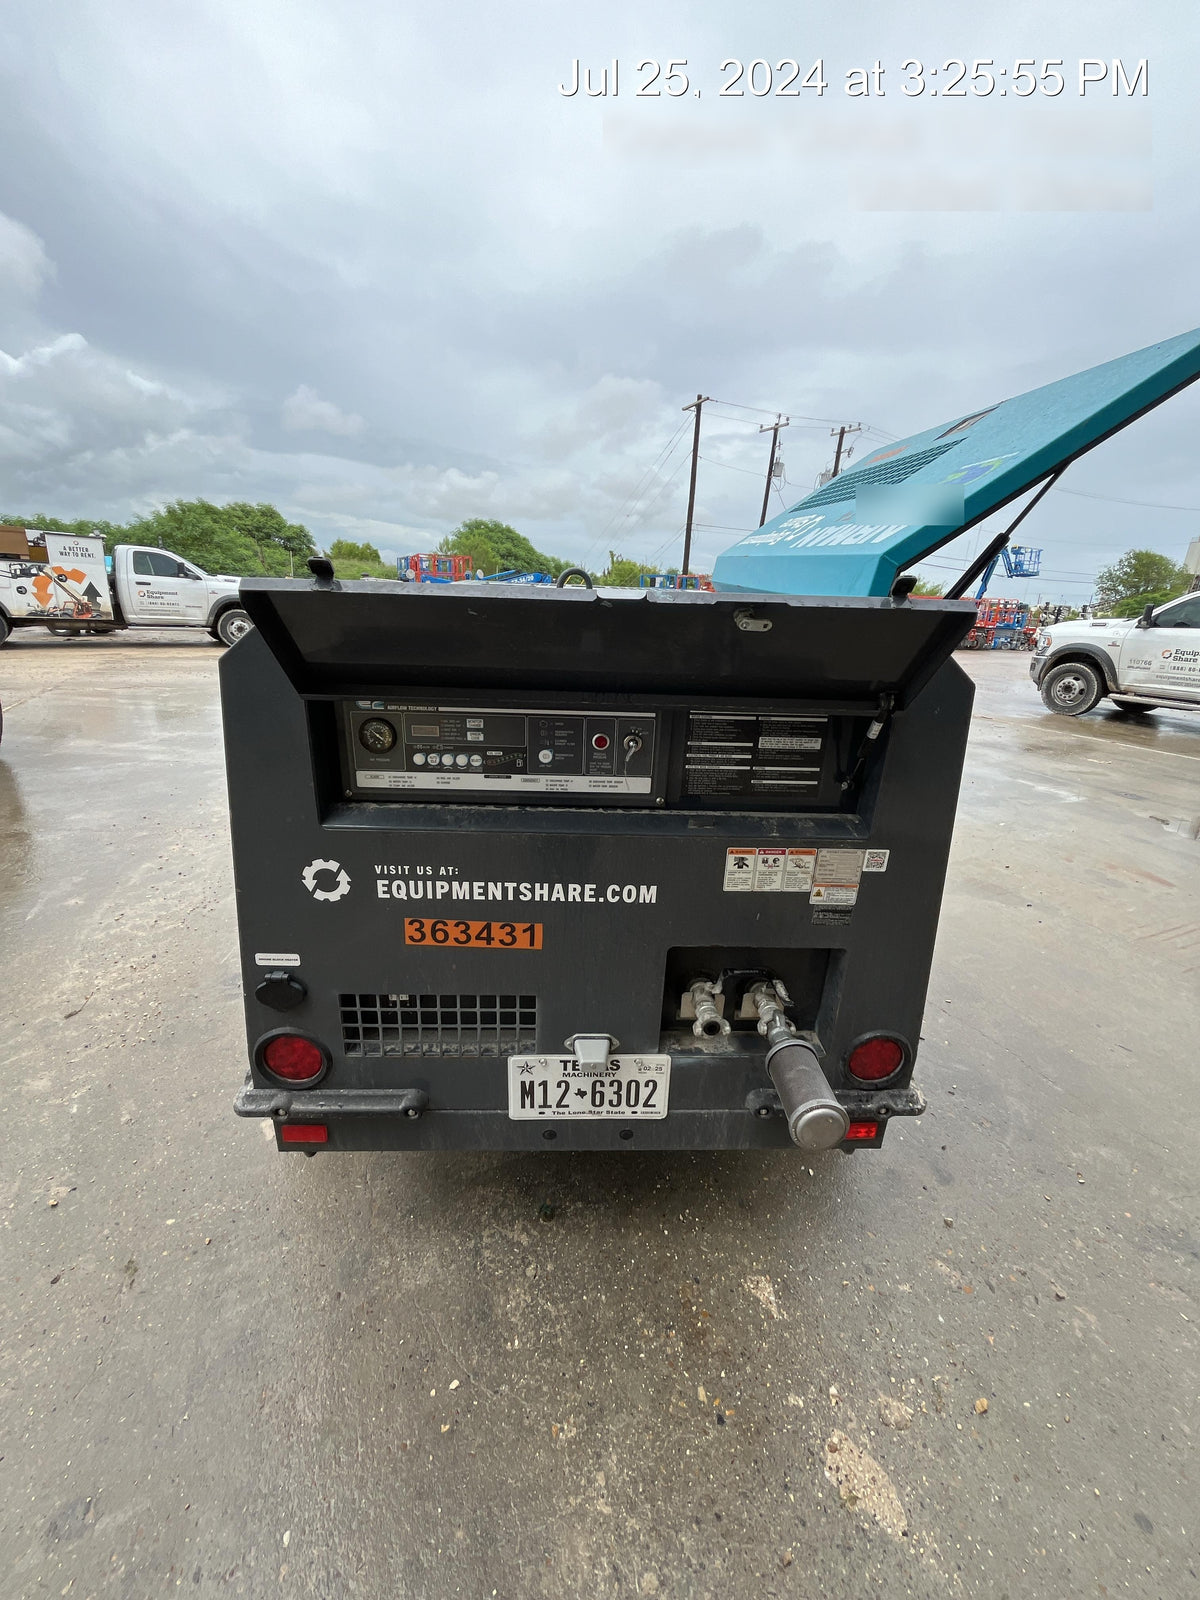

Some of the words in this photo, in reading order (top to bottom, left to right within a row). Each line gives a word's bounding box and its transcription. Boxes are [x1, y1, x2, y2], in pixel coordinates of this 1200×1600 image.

[1174, 648, 1200, 657] Equip
[1172, 655, 1198, 663] Share
[375, 864, 411, 875] VISIT
[416, 866, 433, 875] US
[439, 866, 460, 876] AT:
[376, 879, 658, 904] EQUIPMENTSHARE.COM
[407, 918, 538, 947] 363431
[560, 1060, 621, 1072] TES
[520, 1080, 570, 1109] M12
[591, 1080, 658, 1108] 6302
